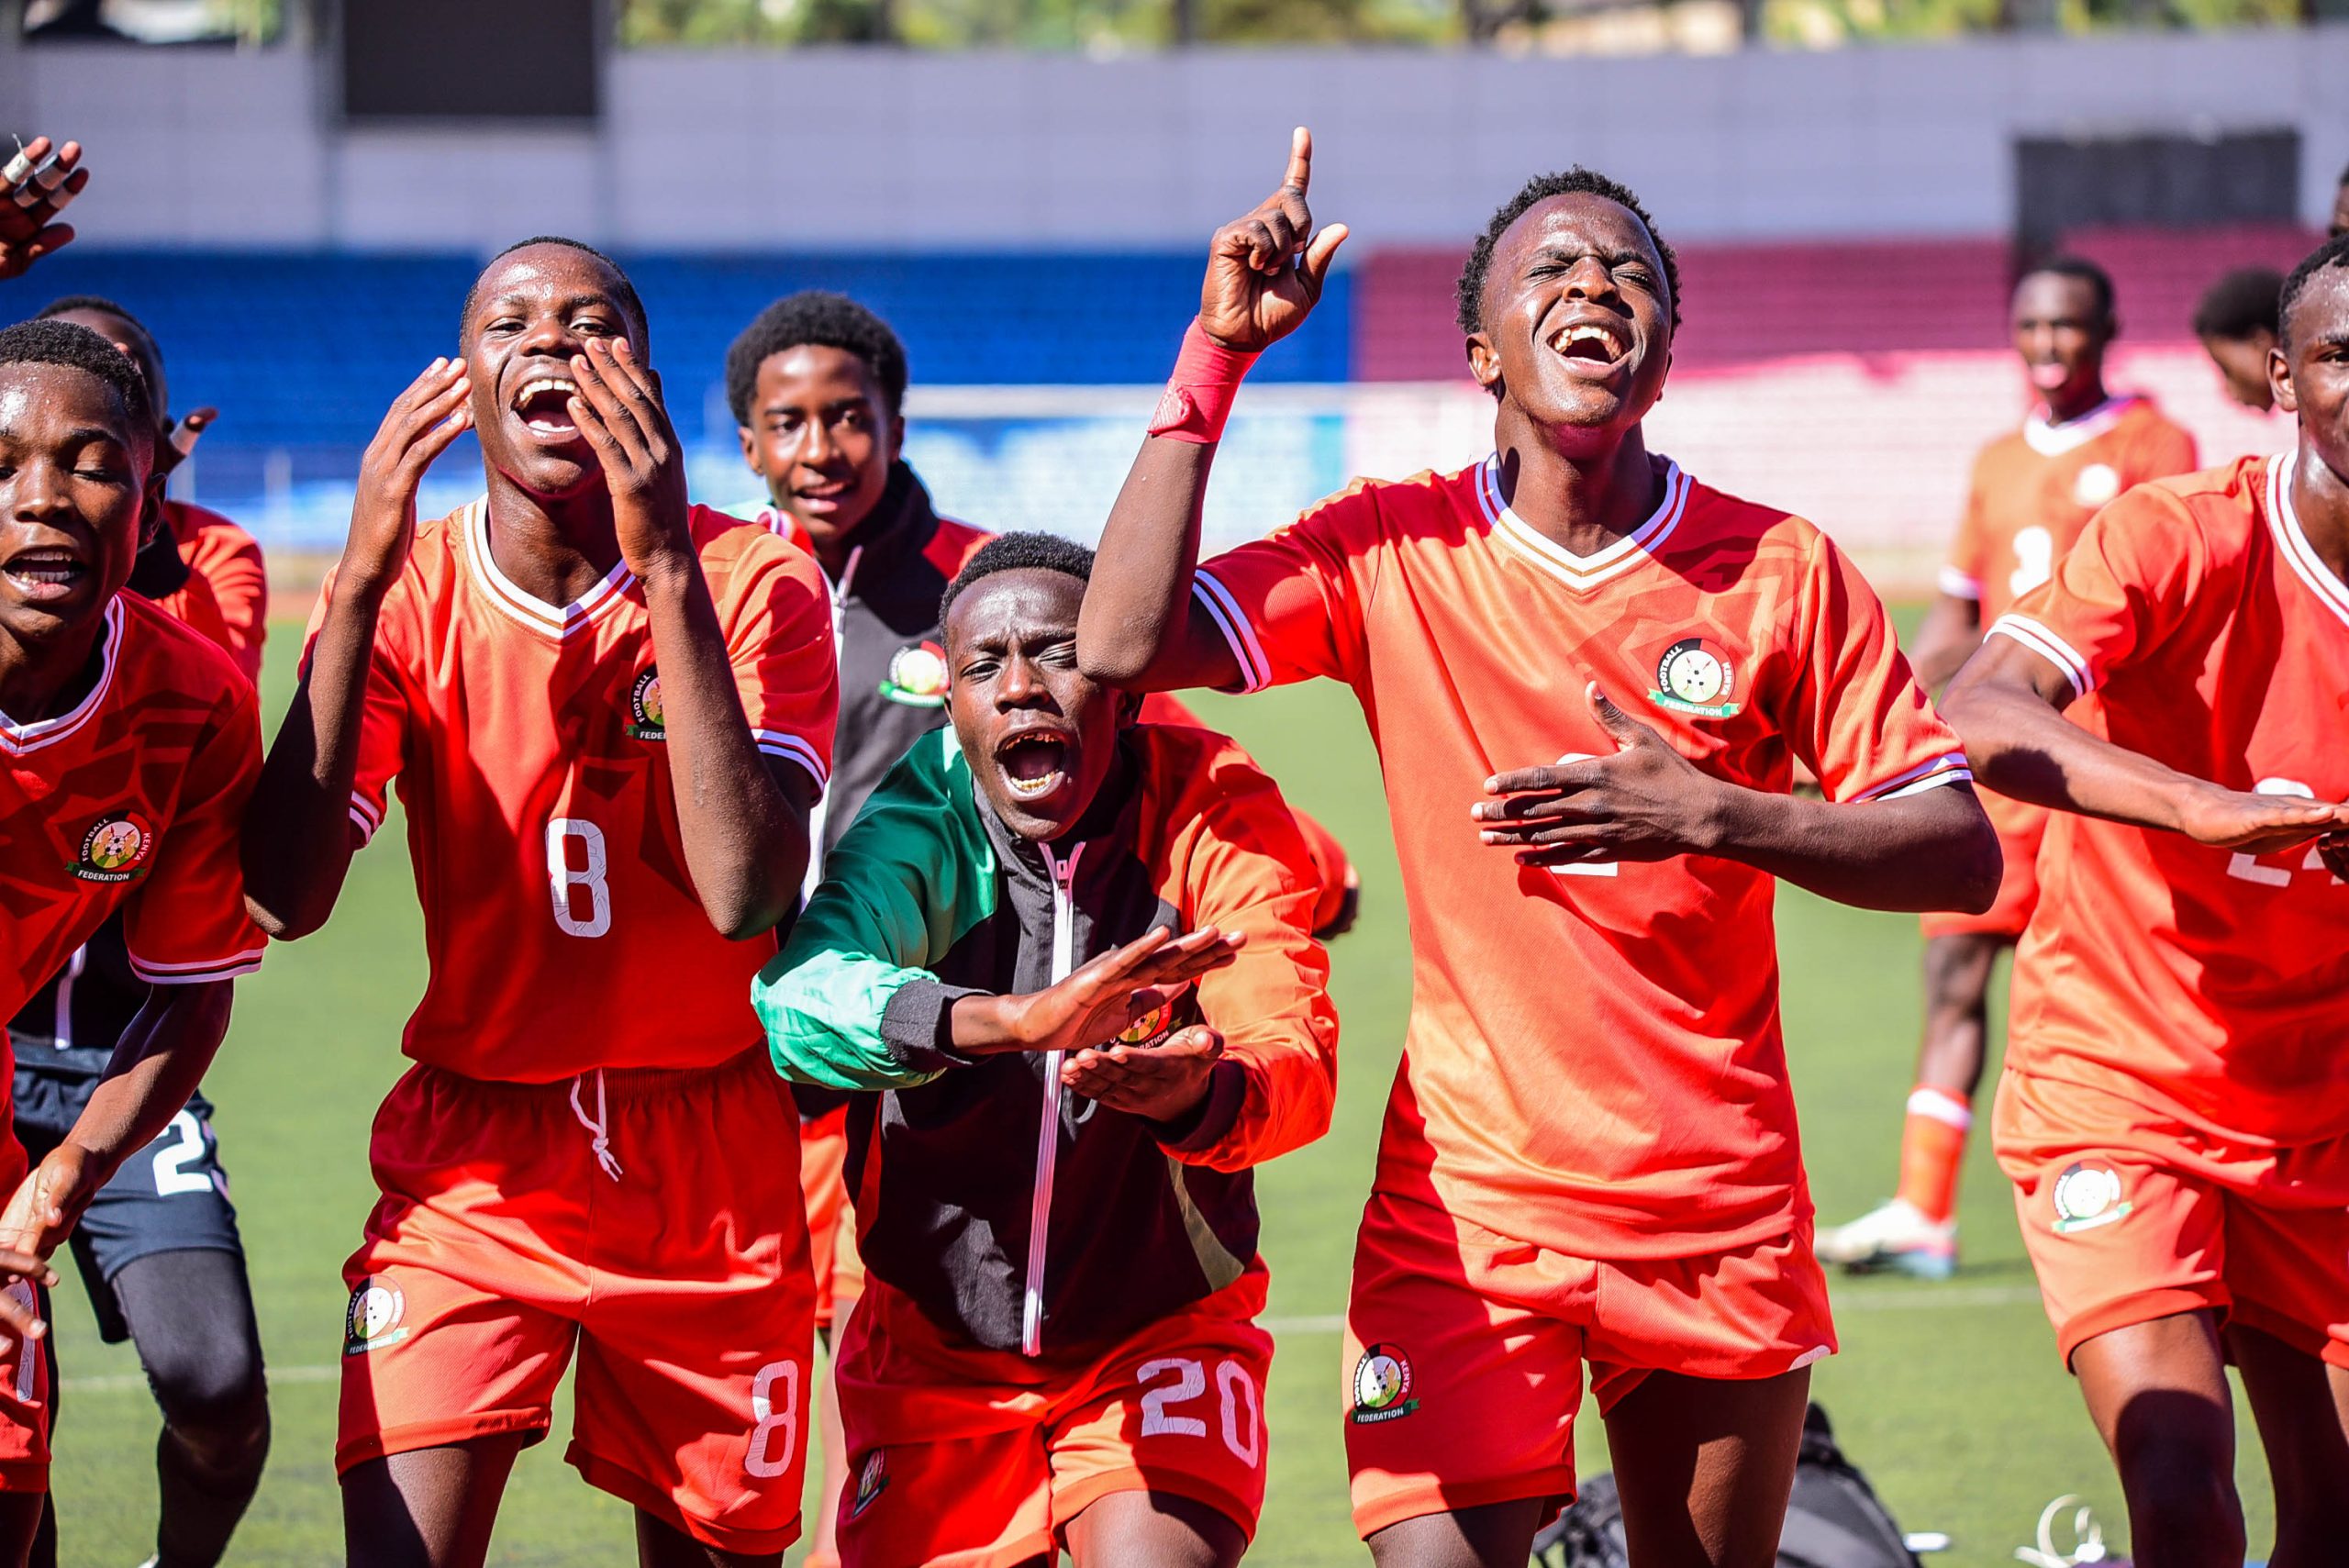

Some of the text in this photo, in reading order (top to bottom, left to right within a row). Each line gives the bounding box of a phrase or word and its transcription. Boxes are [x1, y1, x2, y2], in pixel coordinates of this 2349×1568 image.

[1659, 645, 1683, 693] FOOTBALL
[633, 674, 651, 723] FOOTBALL
[82, 818, 110, 862] FOOTBALL
[133, 832, 150, 862] KENYA
[77, 870, 130, 881] FEDERATION
[545, 817, 611, 938] 8
[152, 1109, 213, 1196] 2
[1399, 1359, 1410, 1394] KENYA
[745, 1360, 798, 1478] 8
[1137, 1358, 1258, 1469] 20
[1357, 1407, 1404, 1423] FEDERATION
